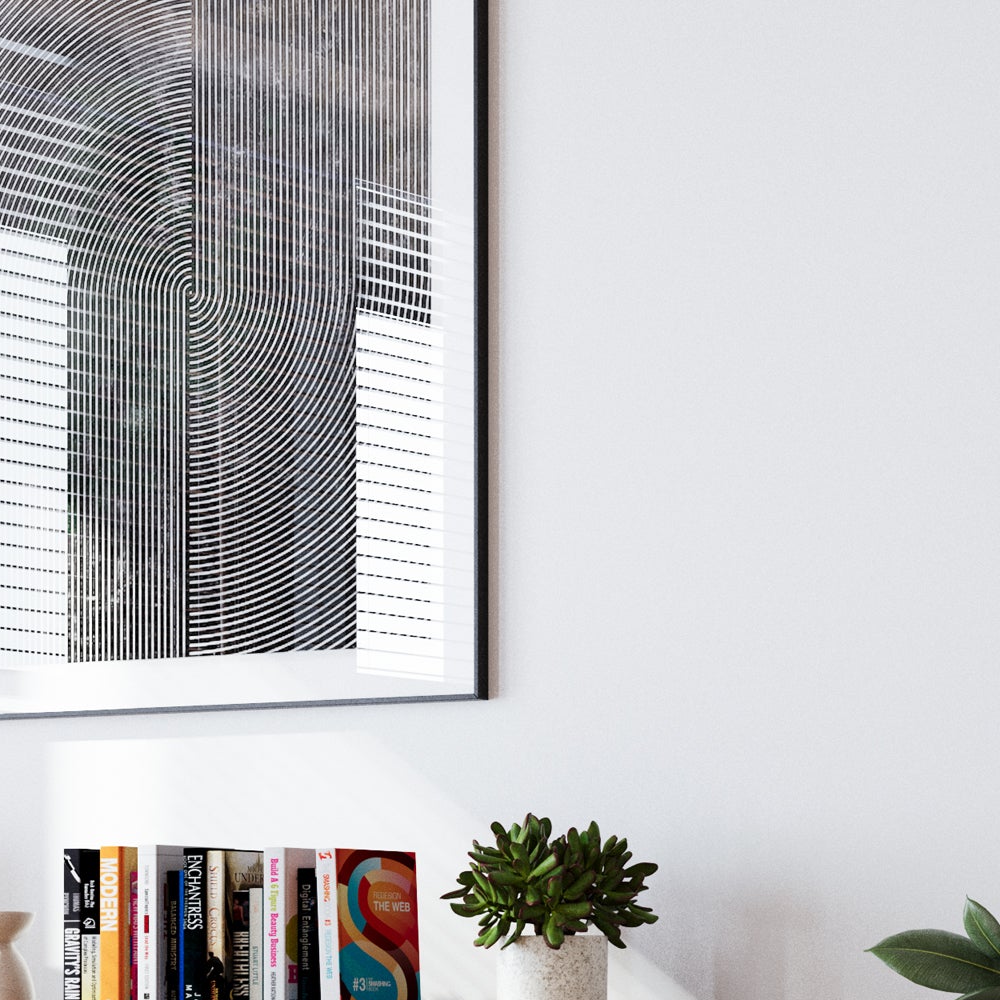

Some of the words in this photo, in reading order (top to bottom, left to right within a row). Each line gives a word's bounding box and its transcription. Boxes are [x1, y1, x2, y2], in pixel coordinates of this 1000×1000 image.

[270, 858, 278, 877] Build
[101, 858, 118, 932] MODERN
[187, 855, 203, 930] ENCHANTRESS
[301, 885, 311, 911] Digital
[373, 901, 390, 912] THE
[392, 902, 411, 912] WEB
[269, 913, 279, 937] Beauty
[65, 928, 81, 975] GRAVITY'S
[270, 938, 278, 967] Business
[301, 916, 311, 970] Entanglement
[353, 977, 366, 991] #3
